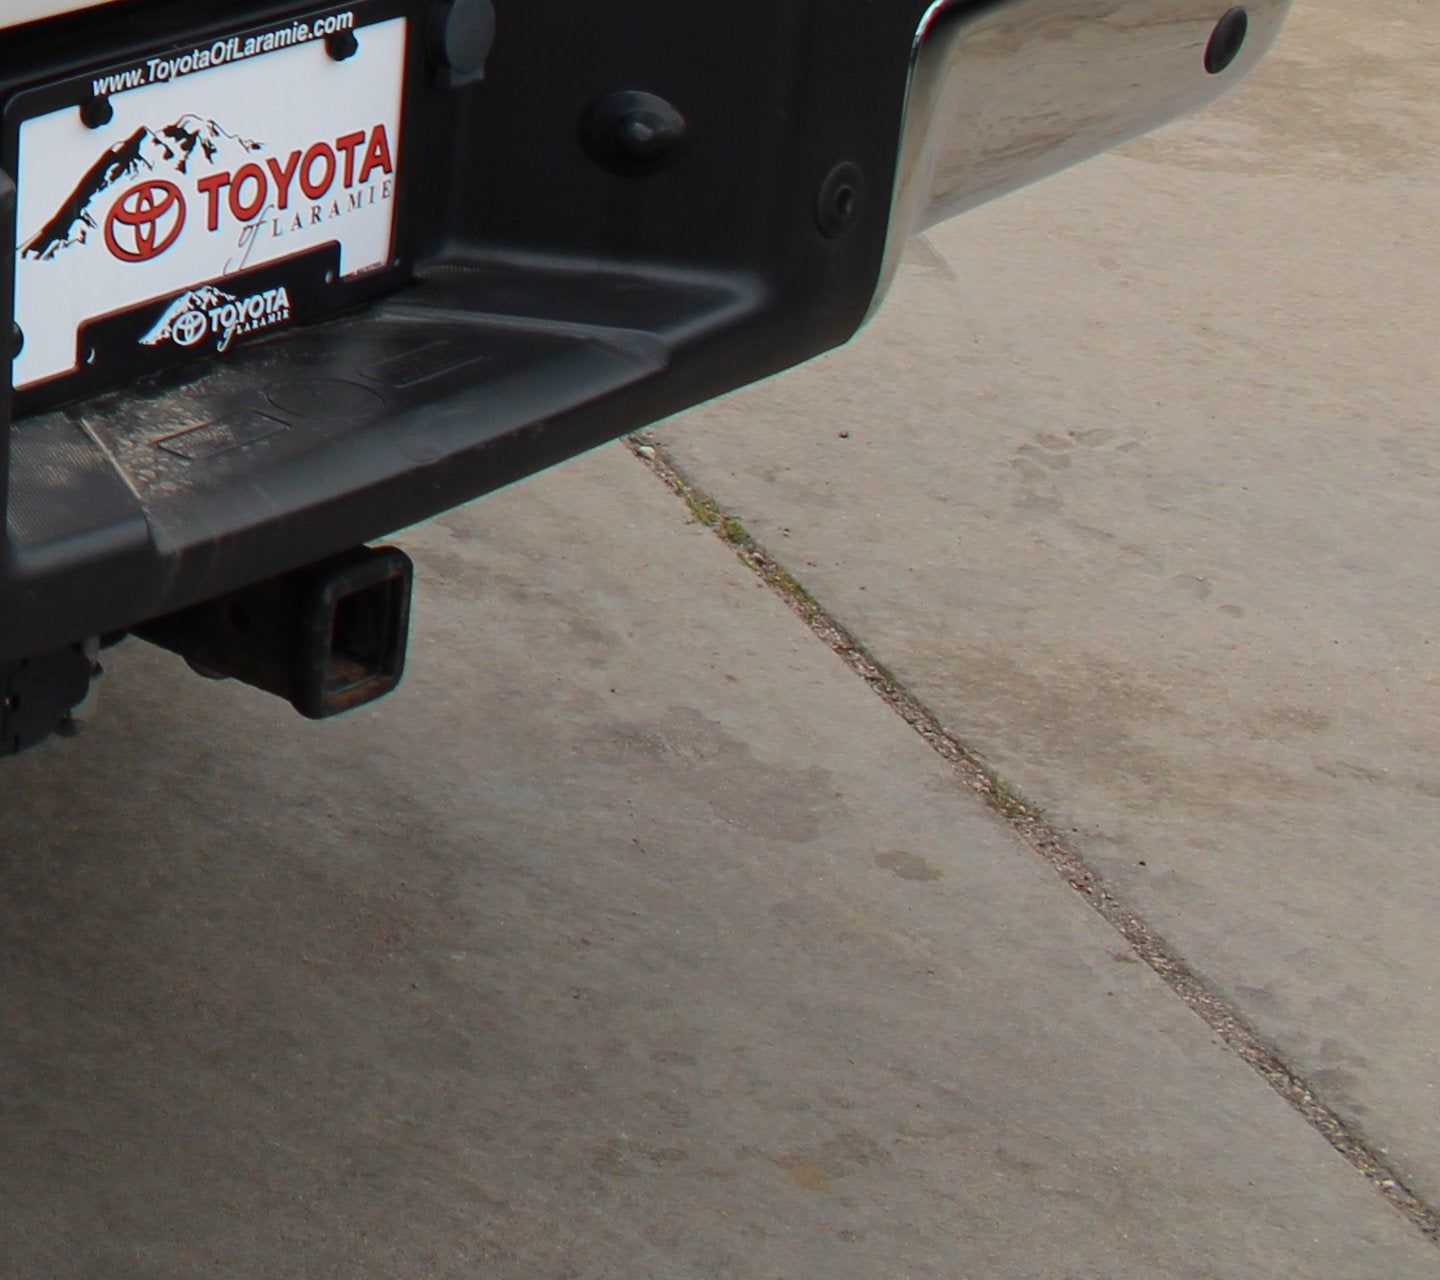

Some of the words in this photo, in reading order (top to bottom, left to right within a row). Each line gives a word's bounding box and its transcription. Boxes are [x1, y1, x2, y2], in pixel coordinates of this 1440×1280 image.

[92, 11, 354, 97] www.ToyotaOfLaramie.com
[197, 123, 393, 232] TOYOTA
[271, 179, 393, 238] LARAMIE
[209, 287, 290, 333] TOYOTA
[236, 309, 290, 335] LARAMIE
